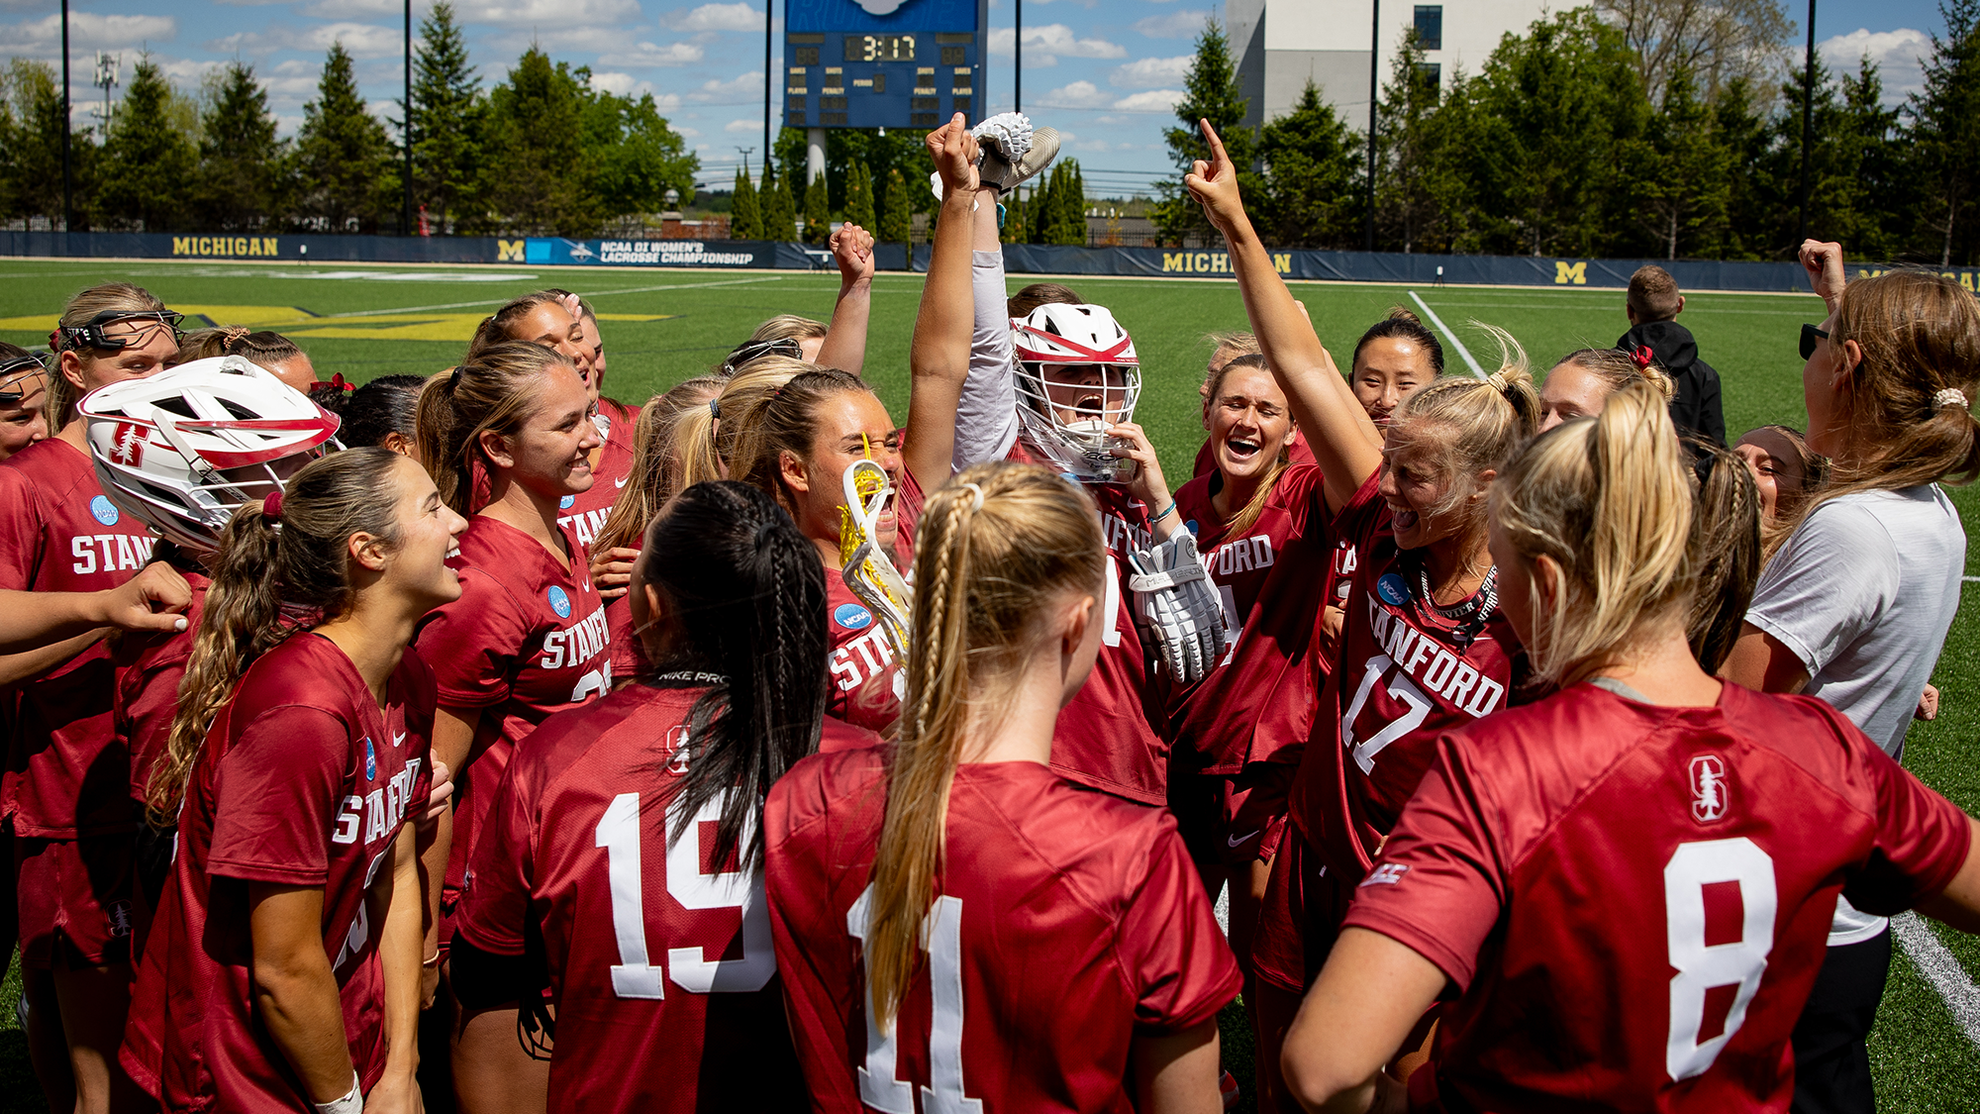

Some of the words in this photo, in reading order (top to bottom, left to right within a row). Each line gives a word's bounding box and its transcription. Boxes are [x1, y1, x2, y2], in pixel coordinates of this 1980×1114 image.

[863, 36, 915, 61] 3:17
[787, 87, 807, 95] PLAYER
[822, 87, 845, 95] PENALTY
[853, 79, 873, 87] PERIOD
[913, 87, 937, 95] PENALTY
[952, 87, 972, 95] PLAYER
[173, 237, 278, 256] MICHIGAN
[497, 240, 525, 261] M
[600, 241, 632, 252] NCAA
[651, 242, 704, 253] WOMEN'S
[600, 252, 660, 263] LACROSSE
[661, 252, 754, 265] CHAMPIONSHIP
[1162, 253, 1292, 273] MICHN
[1555, 261, 1587, 284] M
[72, 534, 158, 574] STAN
[1380, 580, 1405, 605] NCAA
[843, 610, 870, 627] NCAA
[541, 603, 610, 669] STANFO
[658, 670, 694, 681] NIKE
[1342, 653, 1435, 776] 17
[595, 786, 777, 1000] 19
[1664, 836, 1778, 1082] 8
[846, 880, 983, 1114] 11
